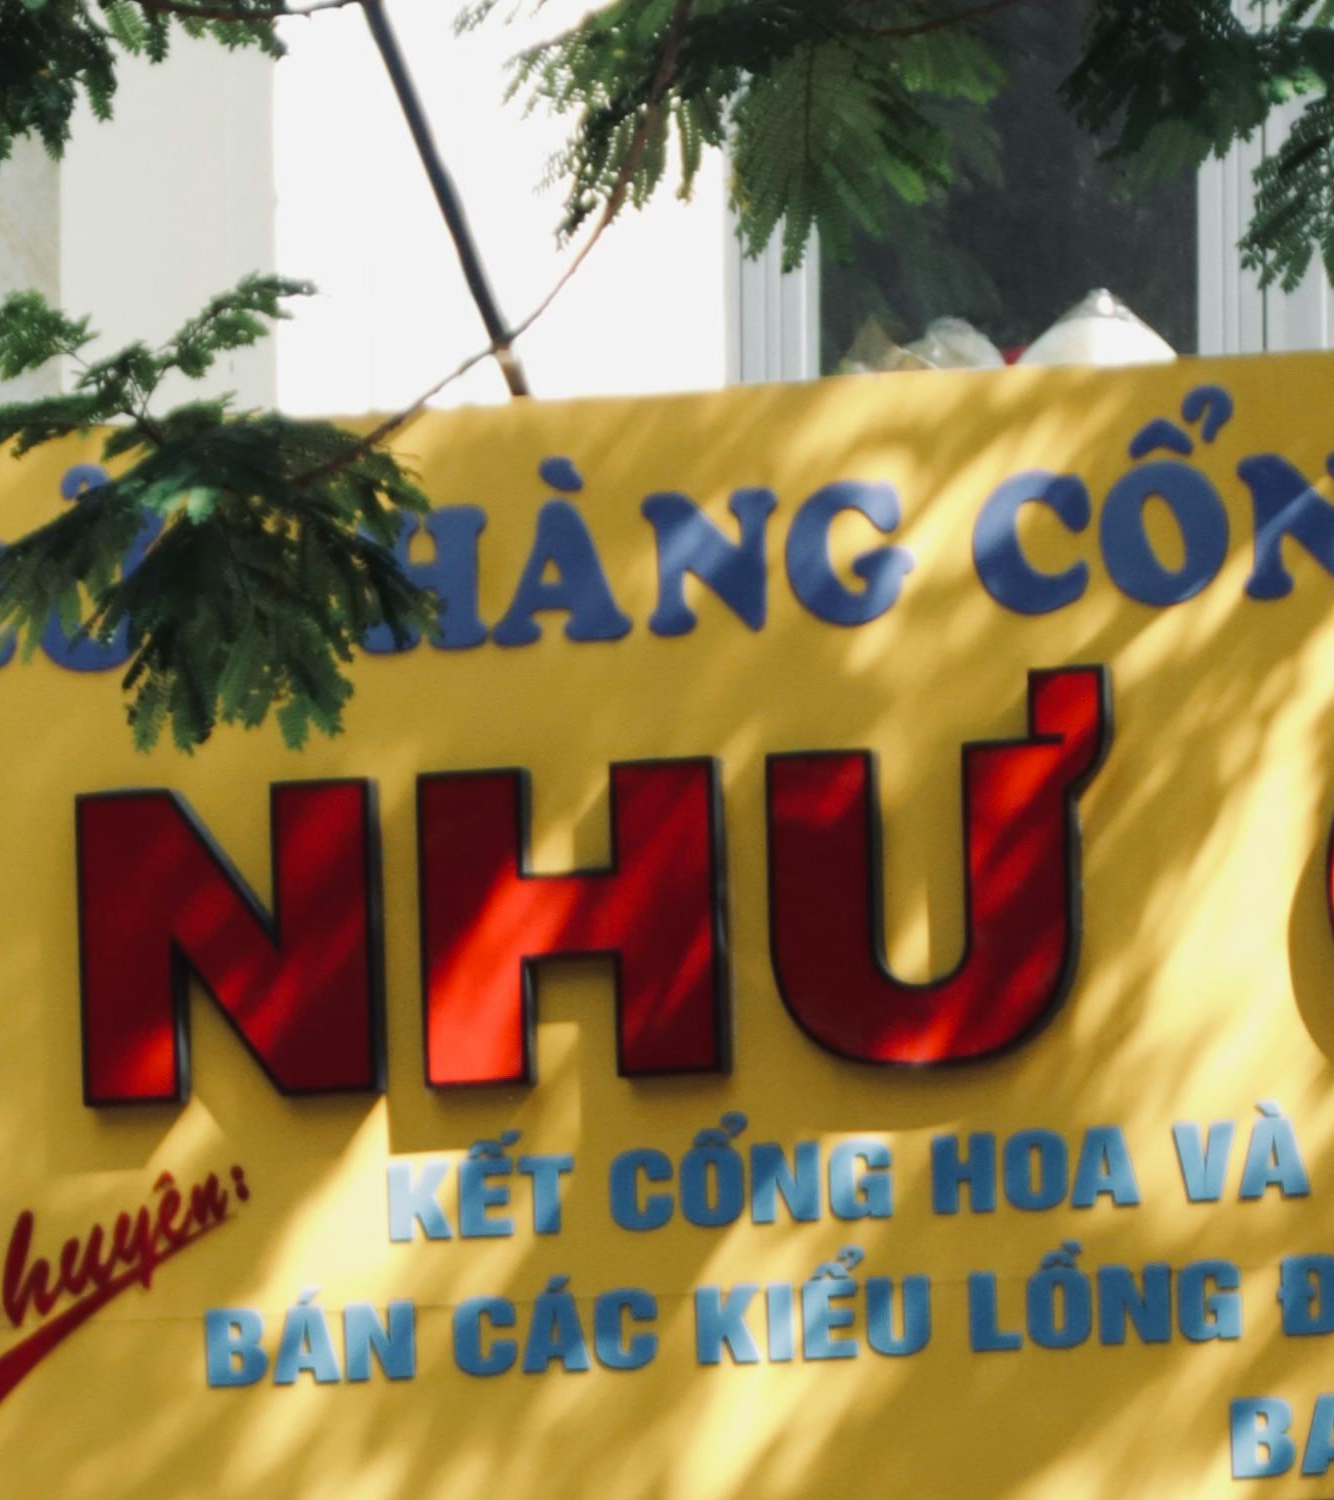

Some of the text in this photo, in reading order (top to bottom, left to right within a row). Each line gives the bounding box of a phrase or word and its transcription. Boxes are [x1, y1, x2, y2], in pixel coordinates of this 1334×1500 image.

[359, 456, 913, 655] HÀNG
[74, 665, 1113, 1108] NHƯ
[387, 1129, 575, 1246] KẾT
[608, 1110, 894, 1231] CỔNG
[929, 1122, 1141, 1213] HOA
[1172, 1102, 1310, 1206] VÀ
[204, 1291, 417, 1388] BÁN
[451, 1277, 659, 1375] CÁC
[694, 1246, 932, 1366] KIỂU
[969, 1241, 1243, 1353] LỒNG
